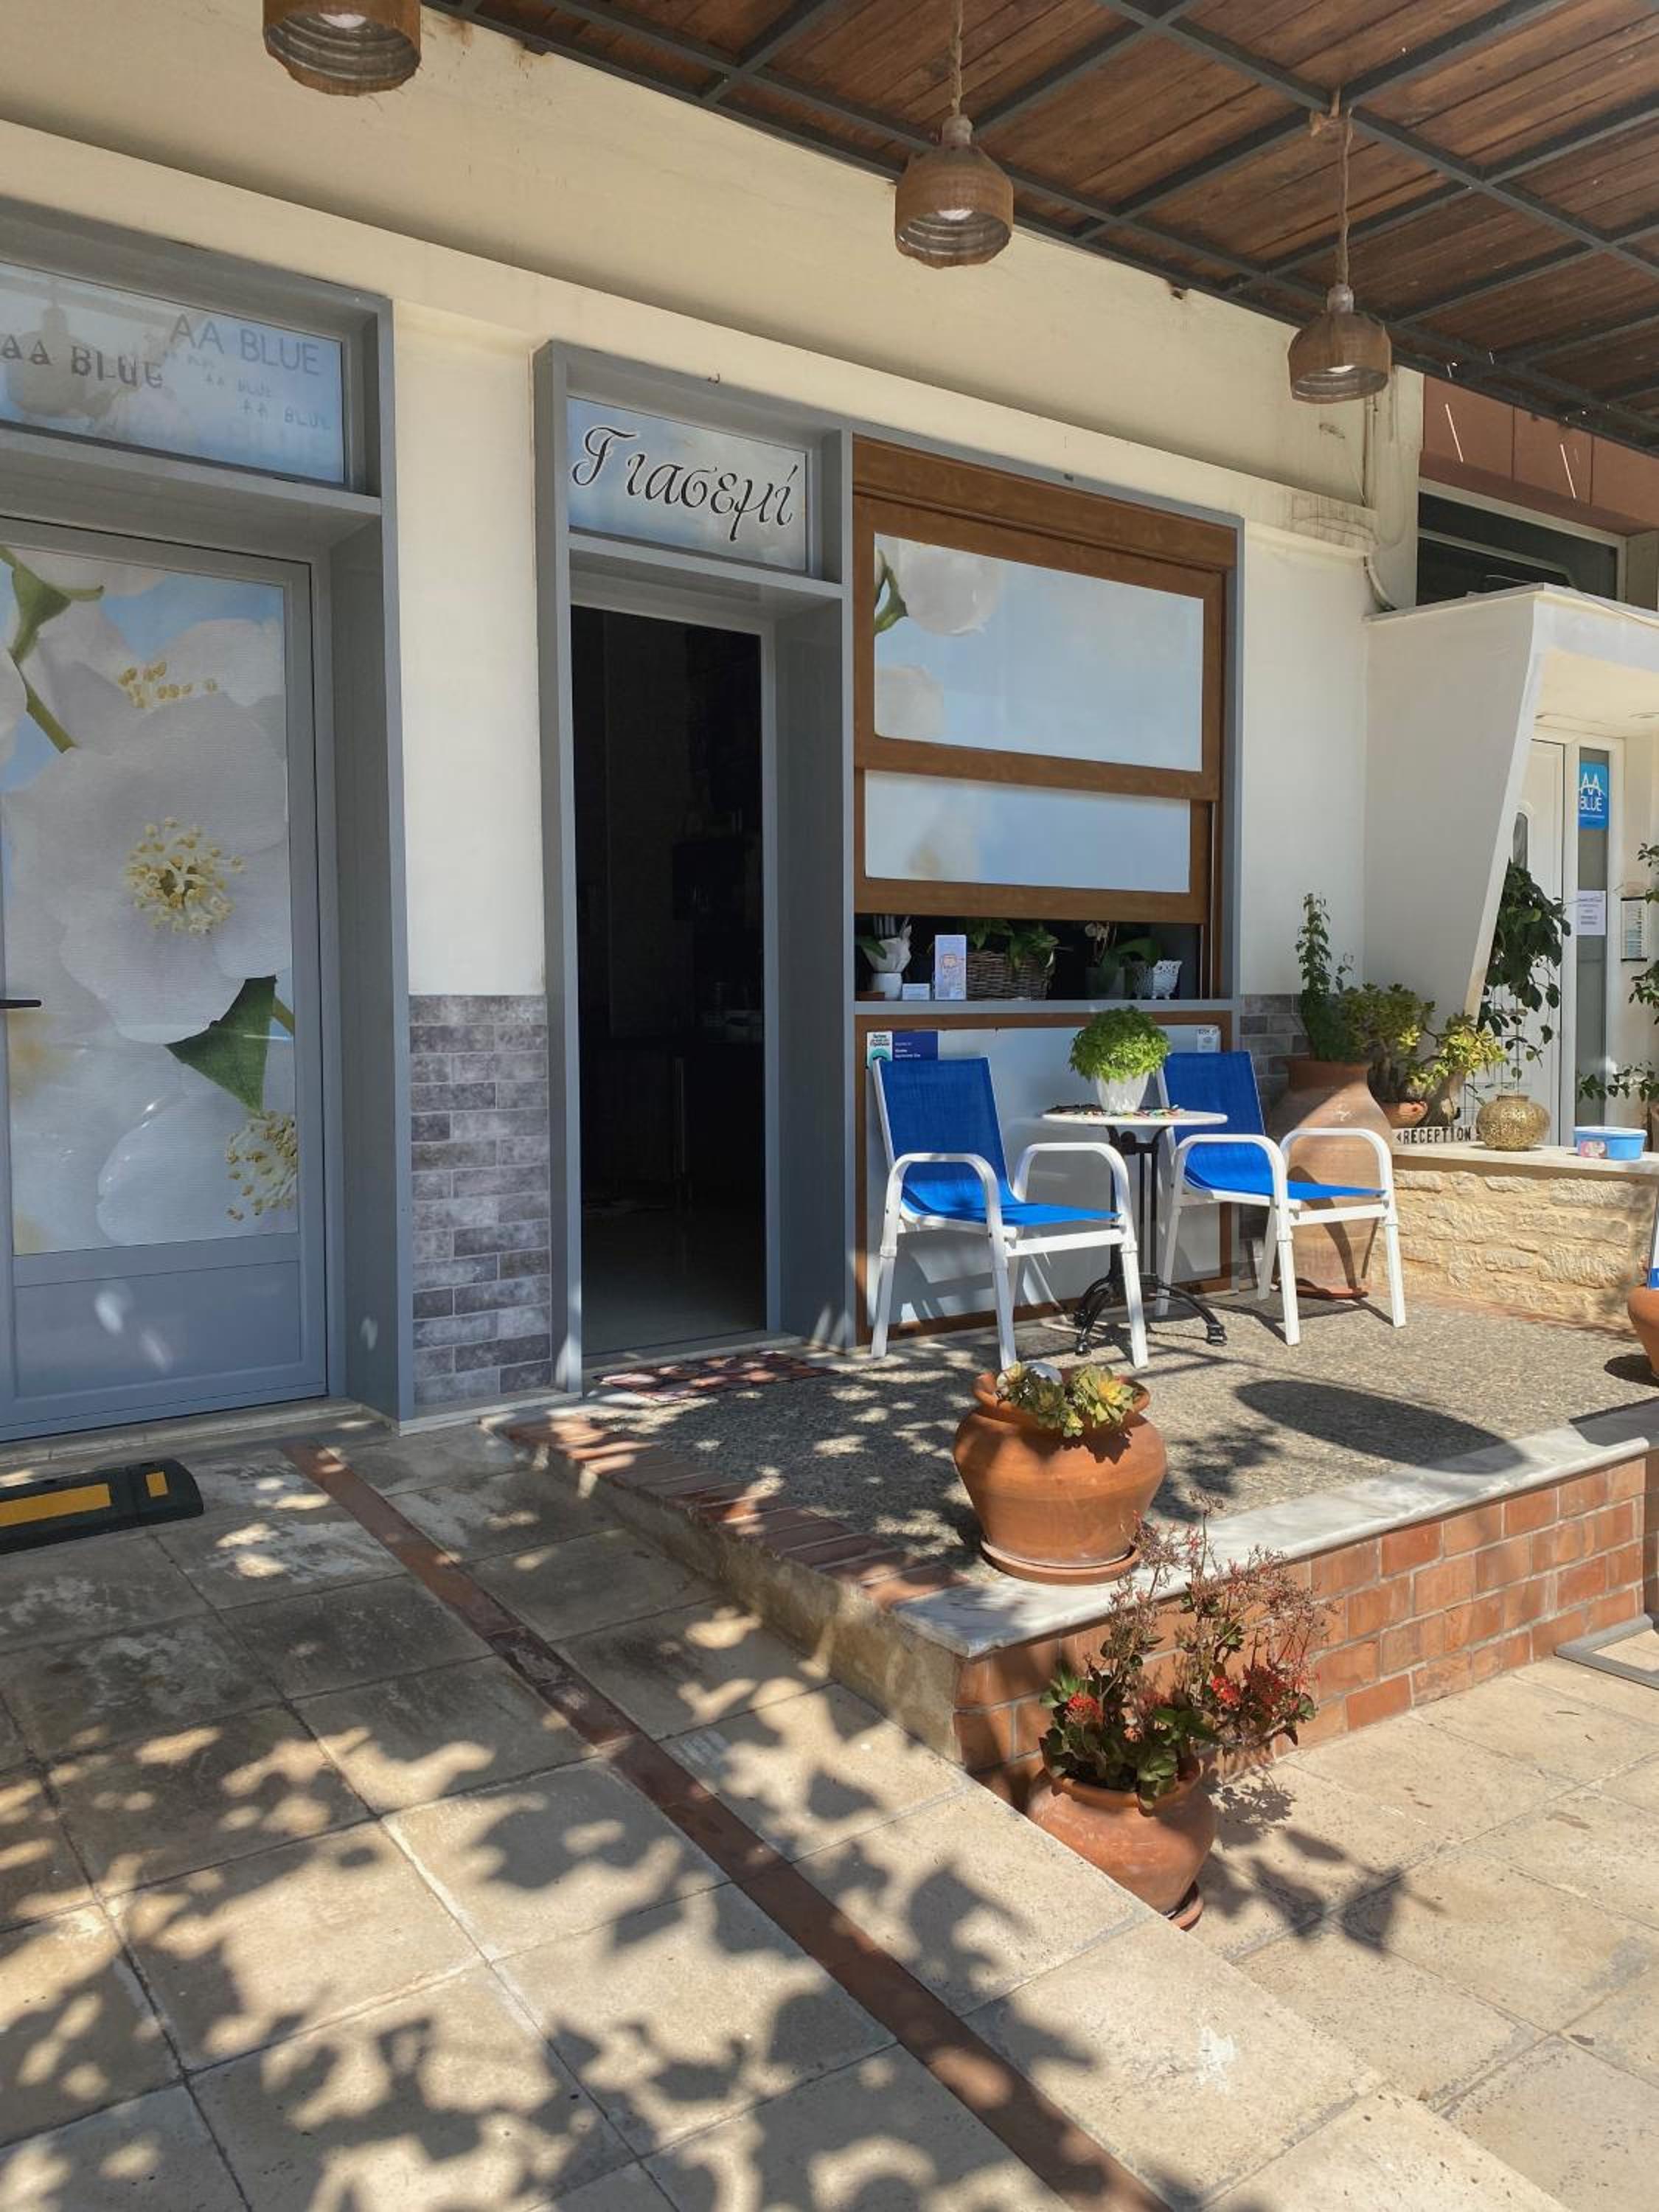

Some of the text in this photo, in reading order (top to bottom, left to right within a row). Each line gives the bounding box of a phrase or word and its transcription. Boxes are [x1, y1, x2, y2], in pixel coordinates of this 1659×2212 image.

[169, 313, 225, 355] AA
[239, 327, 320, 376] BLUE
[571, 426, 799, 542] Γιασεμί
[1580, 795, 1603, 813] BLUE
[1402, 1126, 1472, 1145] RECEPTION
